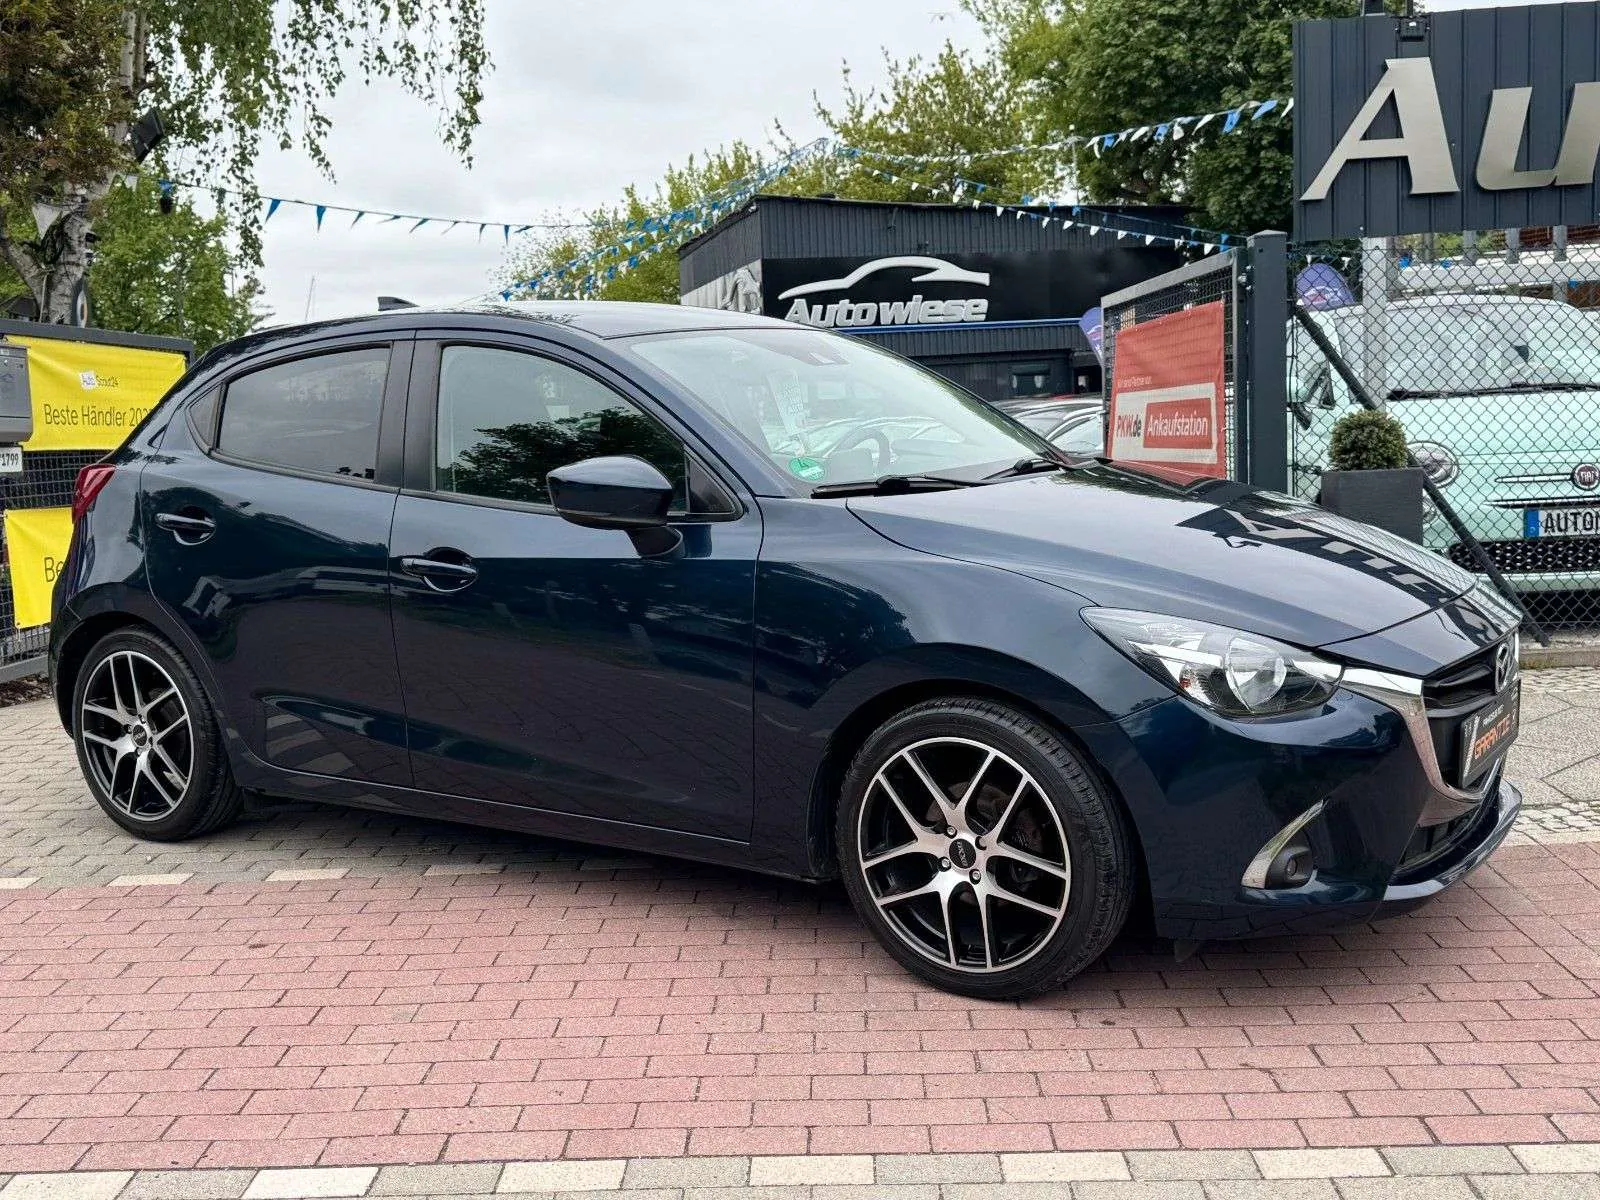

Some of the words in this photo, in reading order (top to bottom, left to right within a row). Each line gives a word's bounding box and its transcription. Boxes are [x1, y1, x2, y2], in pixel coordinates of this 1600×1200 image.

[784, 294, 989, 328] Autowiese
[43, 403, 79, 426] Beste
[81, 405, 127, 427] Händler
[129, 407, 153, 427] 20
[1147, 409, 1208, 437] Ankaufstation
[1544, 511, 1600, 533] AUTO
